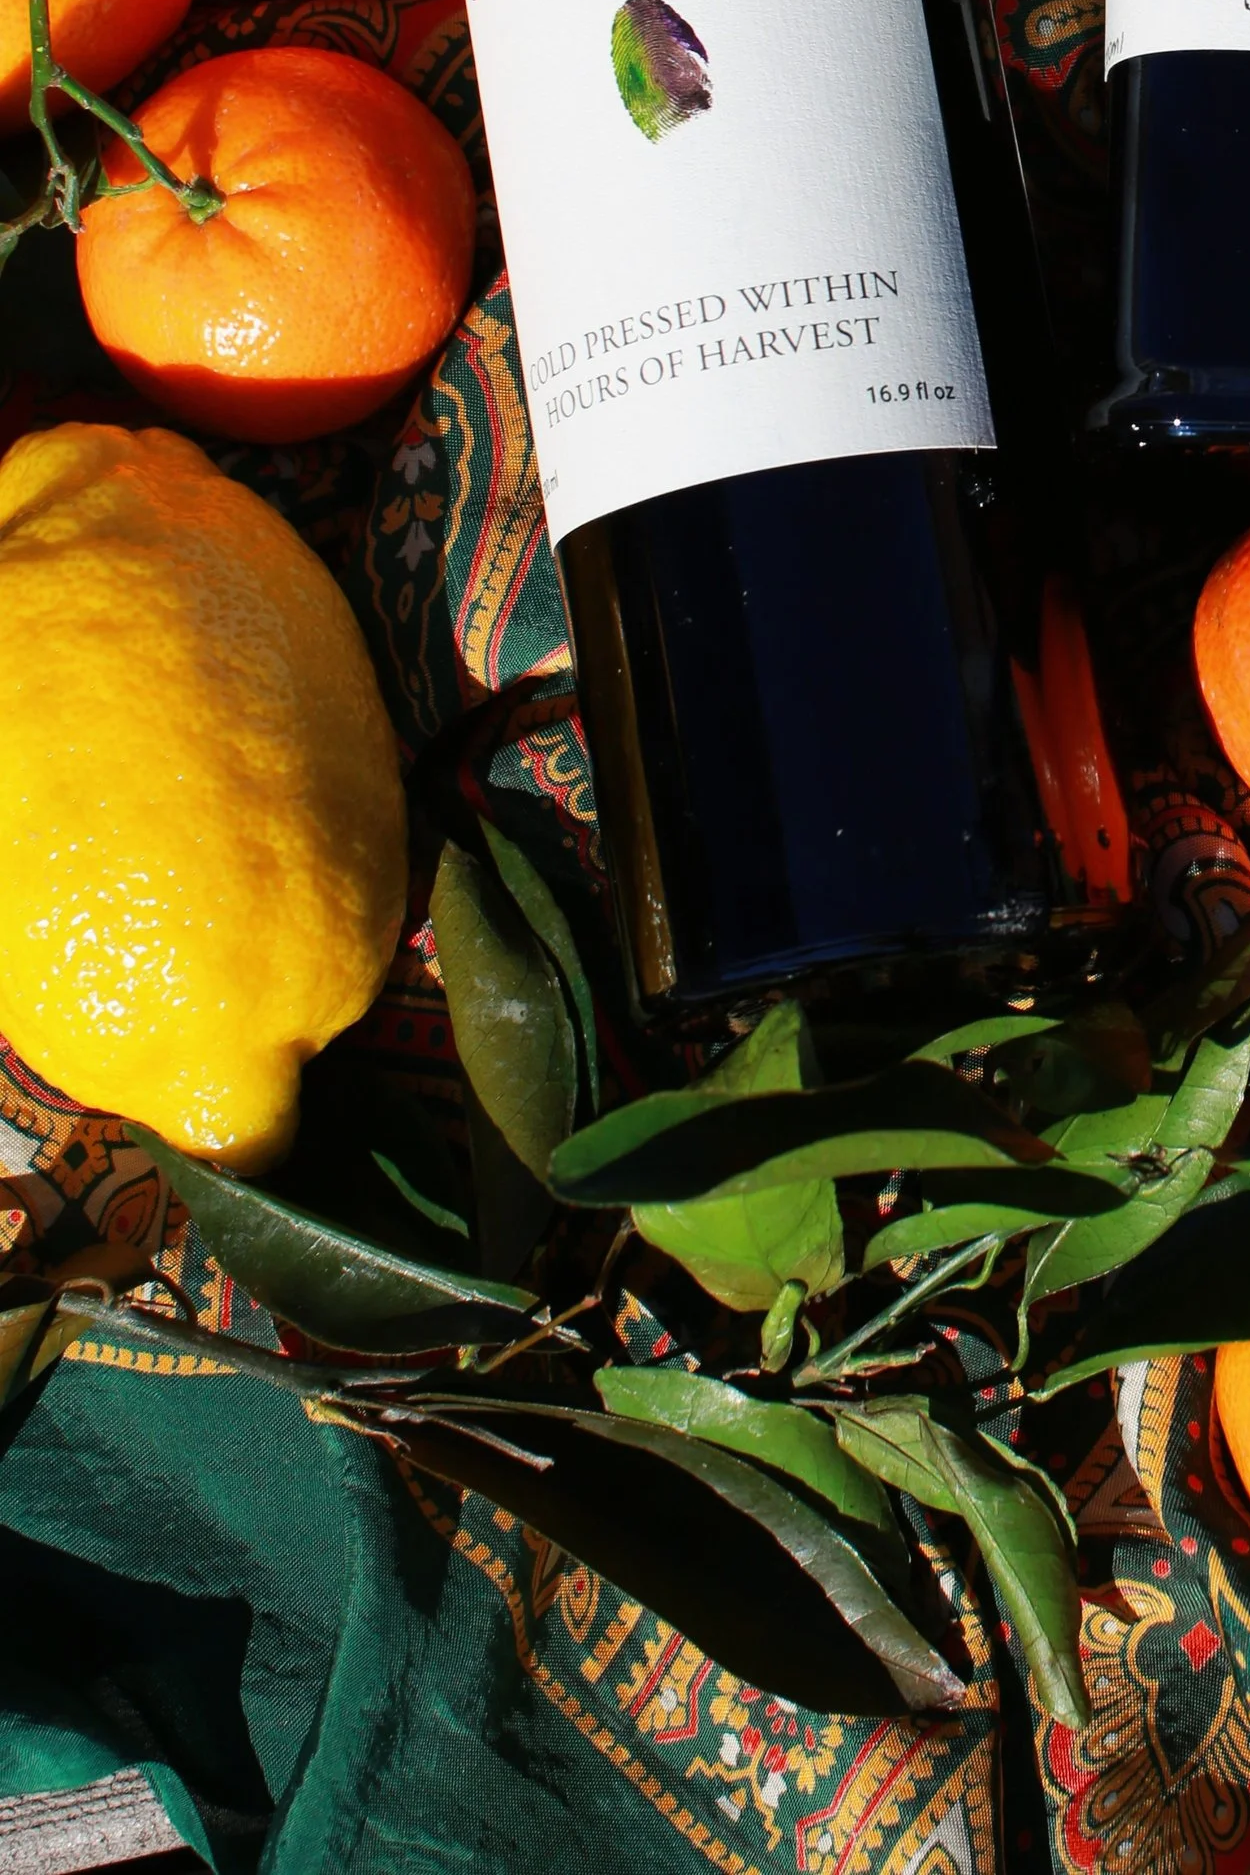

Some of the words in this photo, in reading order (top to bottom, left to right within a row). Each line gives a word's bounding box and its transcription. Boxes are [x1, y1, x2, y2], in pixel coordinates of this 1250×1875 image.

[529, 341, 576, 392] COLD
[583, 293, 727, 360] PRESSED
[737, 270, 900, 313] WITHIN
[545, 365, 629, 429] HOURS
[639, 349, 686, 386] OF
[696, 316, 881, 372] HARVEST
[866, 382, 911, 405] 16.9
[915, 382, 930, 401] fl
[933, 383, 956, 401] oz
